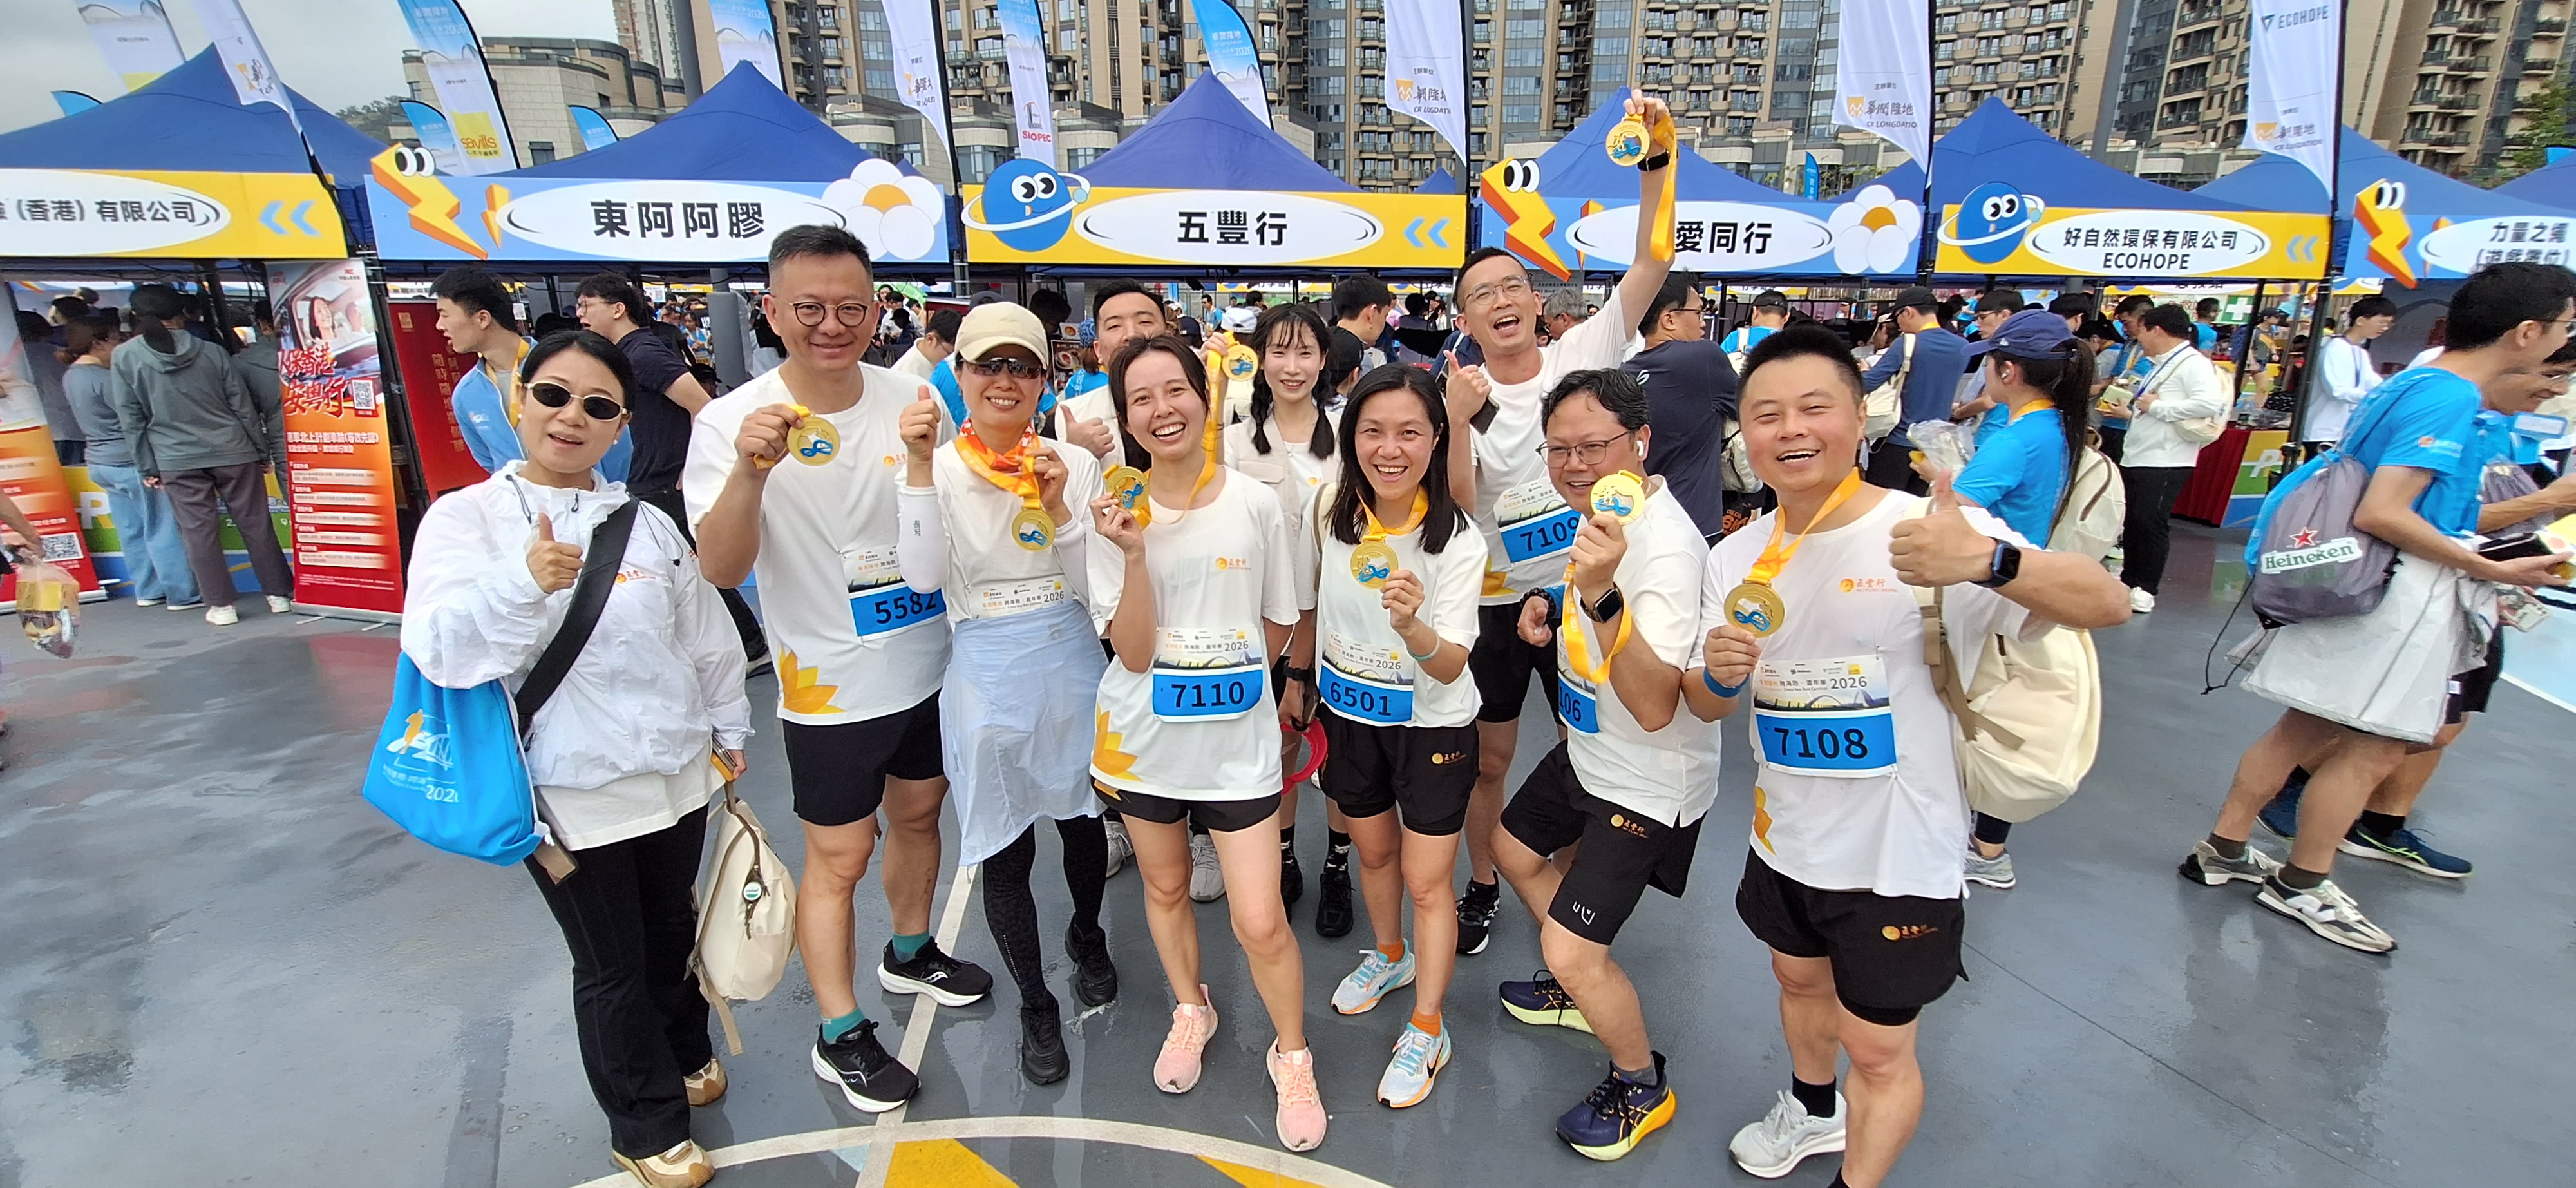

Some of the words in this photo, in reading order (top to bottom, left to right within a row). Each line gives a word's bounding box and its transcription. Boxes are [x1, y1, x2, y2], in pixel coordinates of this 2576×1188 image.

[2278, 5, 2329, 29] ECOHOPE
[1235, 46, 1252, 56] 2026
[460, 135, 497, 149] savills
[1022, 130, 1052, 142] SIOPEC
[589, 200, 765, 239] 東阿阿膠
[1177, 211, 1288, 246] 五豐行
[1674, 221, 1773, 254] 愛同行
[2063, 227, 2238, 250] 好自然環保有限公司
[2103, 253, 2190, 269] ECOHOPE
[1520, 517, 1580, 551] 7109
[2265, 545, 2354, 569] Heineken
[875, 593, 937, 624] 5582
[1043, 591, 1064, 603] 2026
[1224, 640, 1249, 651] 2026
[1376, 660, 1401, 670] 2026
[1171, 681, 1244, 708] 7110
[1830, 676, 1867, 689] 2026
[1330, 681, 1391, 716] 6501
[1559, 686, 1582, 722] 106
[1774, 727, 1868, 759] 7108
